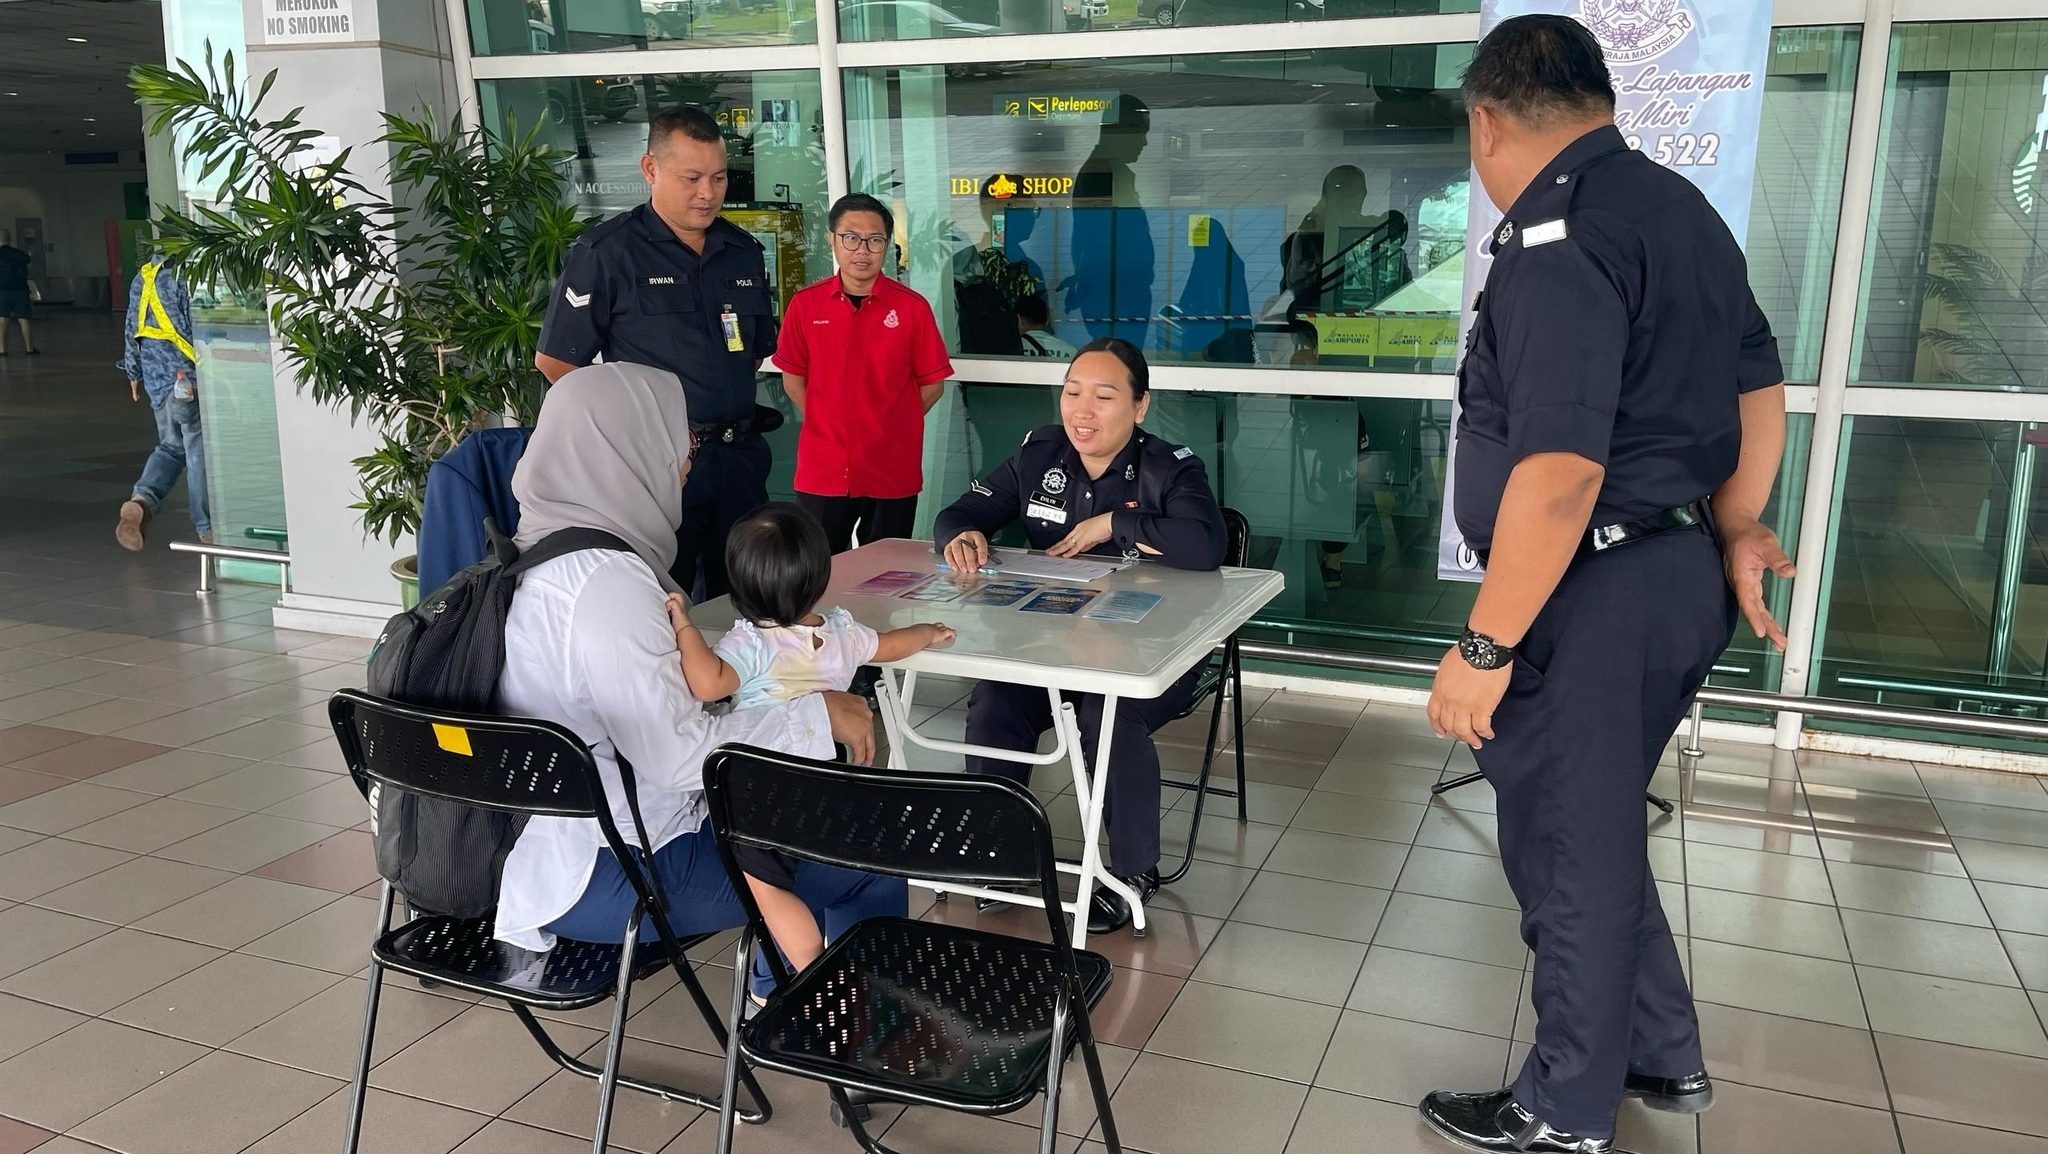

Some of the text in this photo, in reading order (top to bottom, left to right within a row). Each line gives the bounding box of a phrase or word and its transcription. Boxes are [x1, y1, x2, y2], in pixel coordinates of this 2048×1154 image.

[267, 15, 350, 35] NO SMOKING
[1632, 34, 1676, 59] MALAYSIA
[1623, 66, 1752, 99] Lapangan
[1051, 96, 1113, 114] Perlepasan
[1631, 100, 1694, 129] Miri
[1654, 133, 1720, 166] 522
[951, 178, 980, 195] IBI
[1022, 177, 1073, 195] SHOP
[736, 279, 752, 287] POLIS
